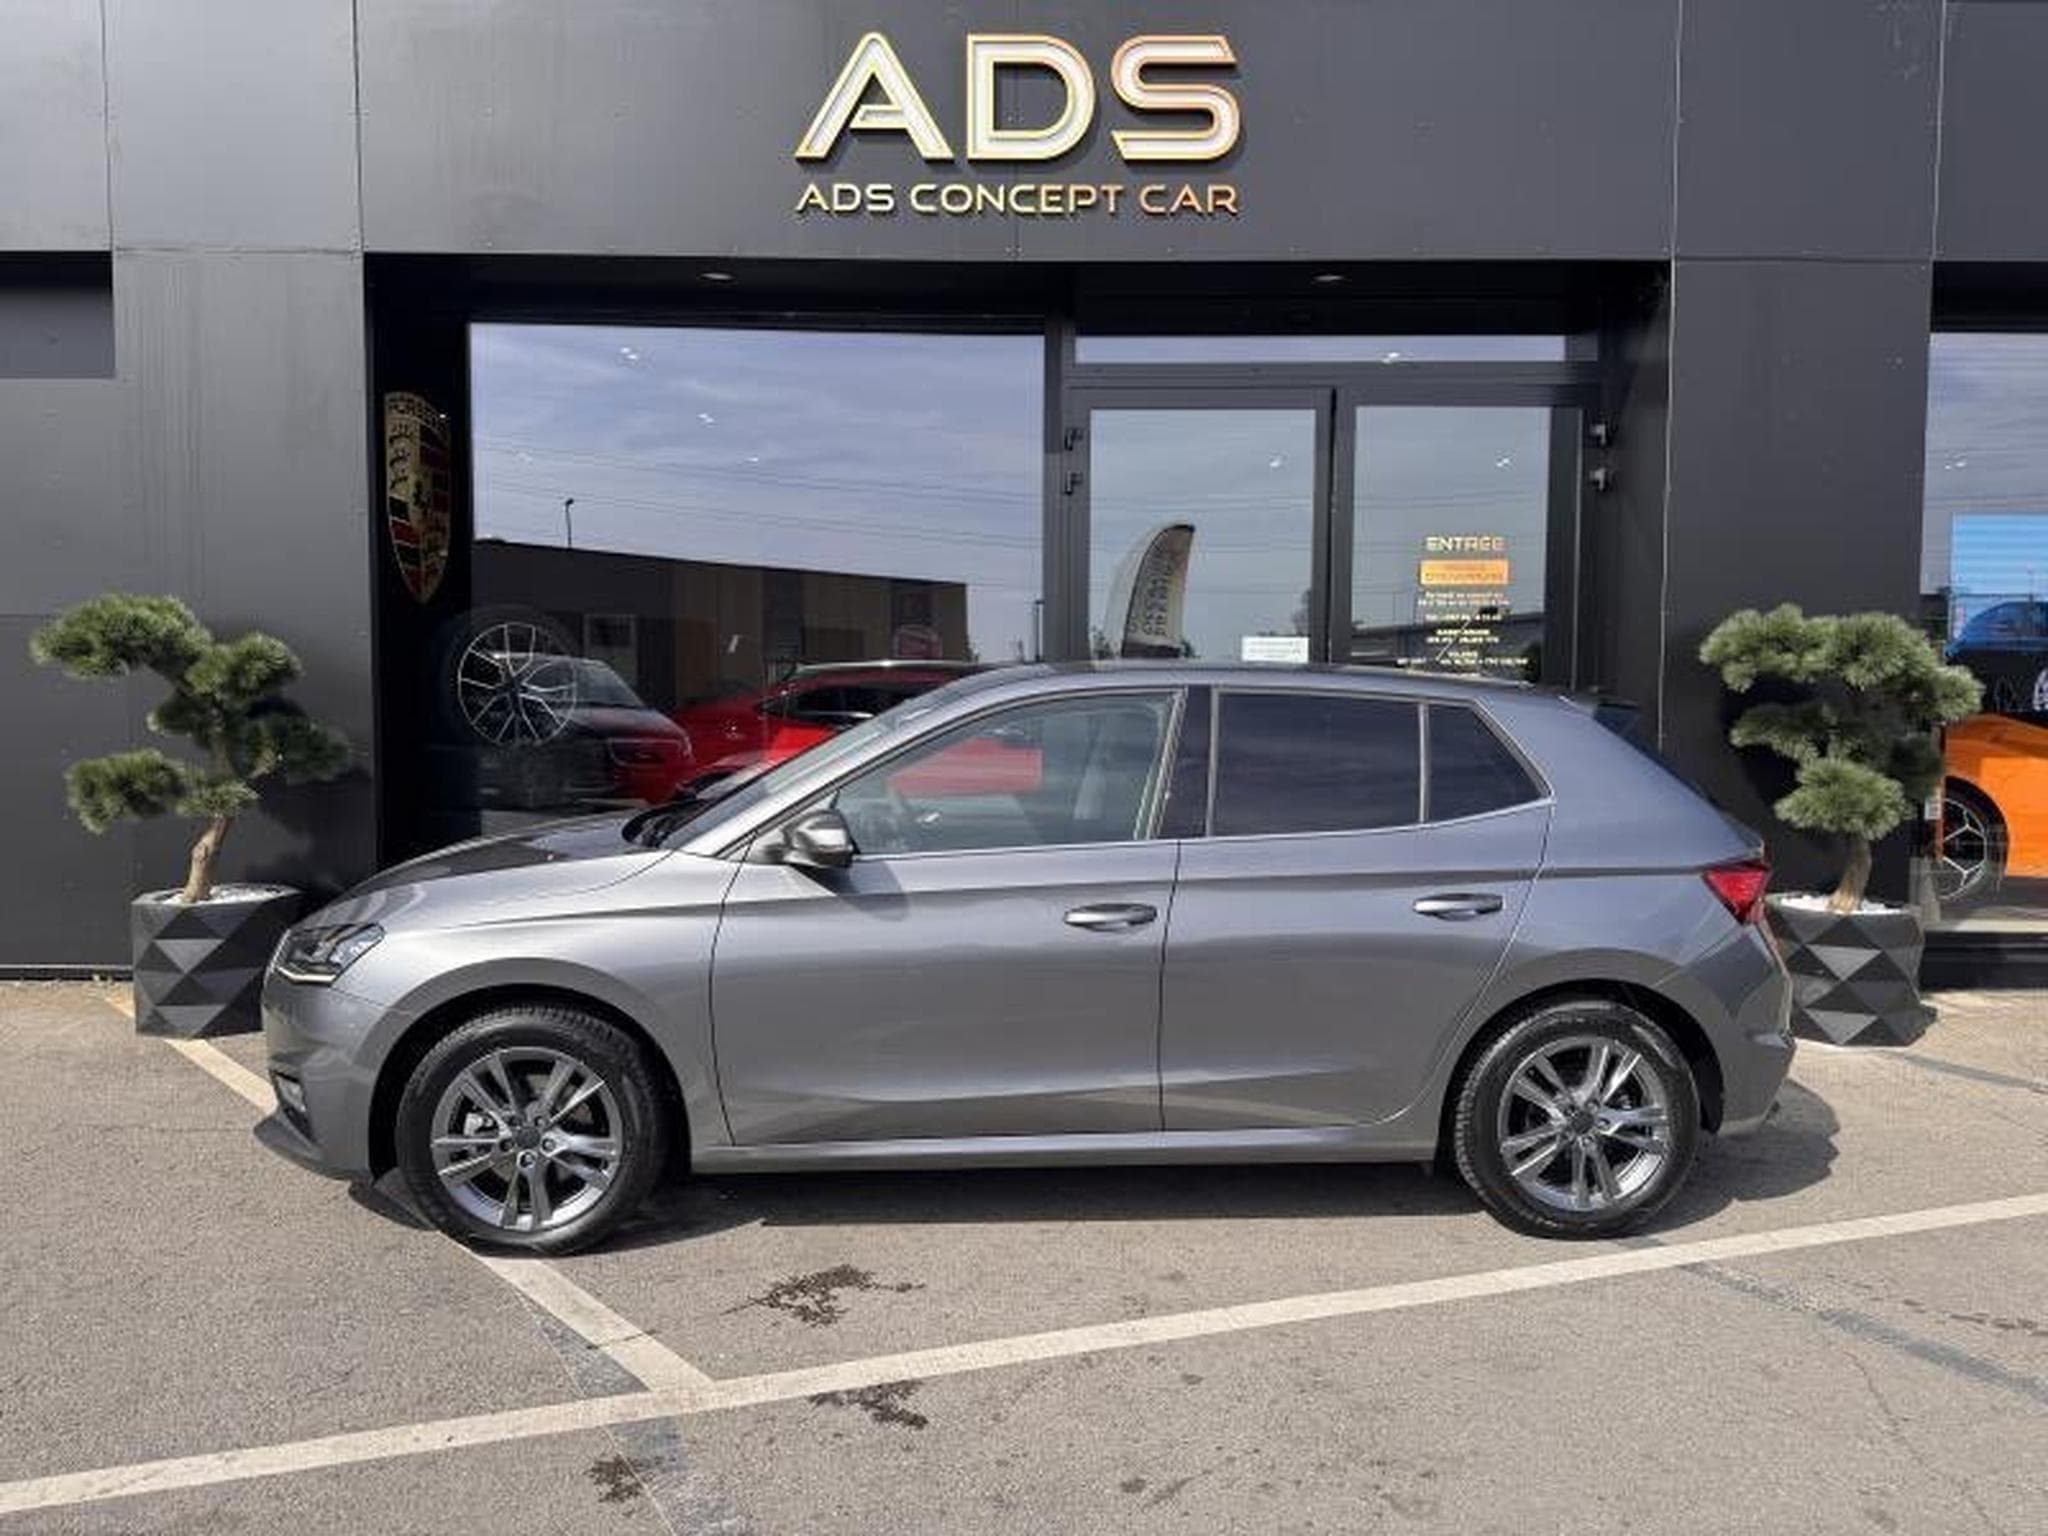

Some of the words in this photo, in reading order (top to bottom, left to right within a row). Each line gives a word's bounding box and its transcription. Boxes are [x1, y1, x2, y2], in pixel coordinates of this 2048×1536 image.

[795, 31, 1240, 161] ADS
[797, 182, 894, 213] ADS
[910, 183, 1123, 214] CONCEPT
[1140, 184, 1240, 215] CAR
